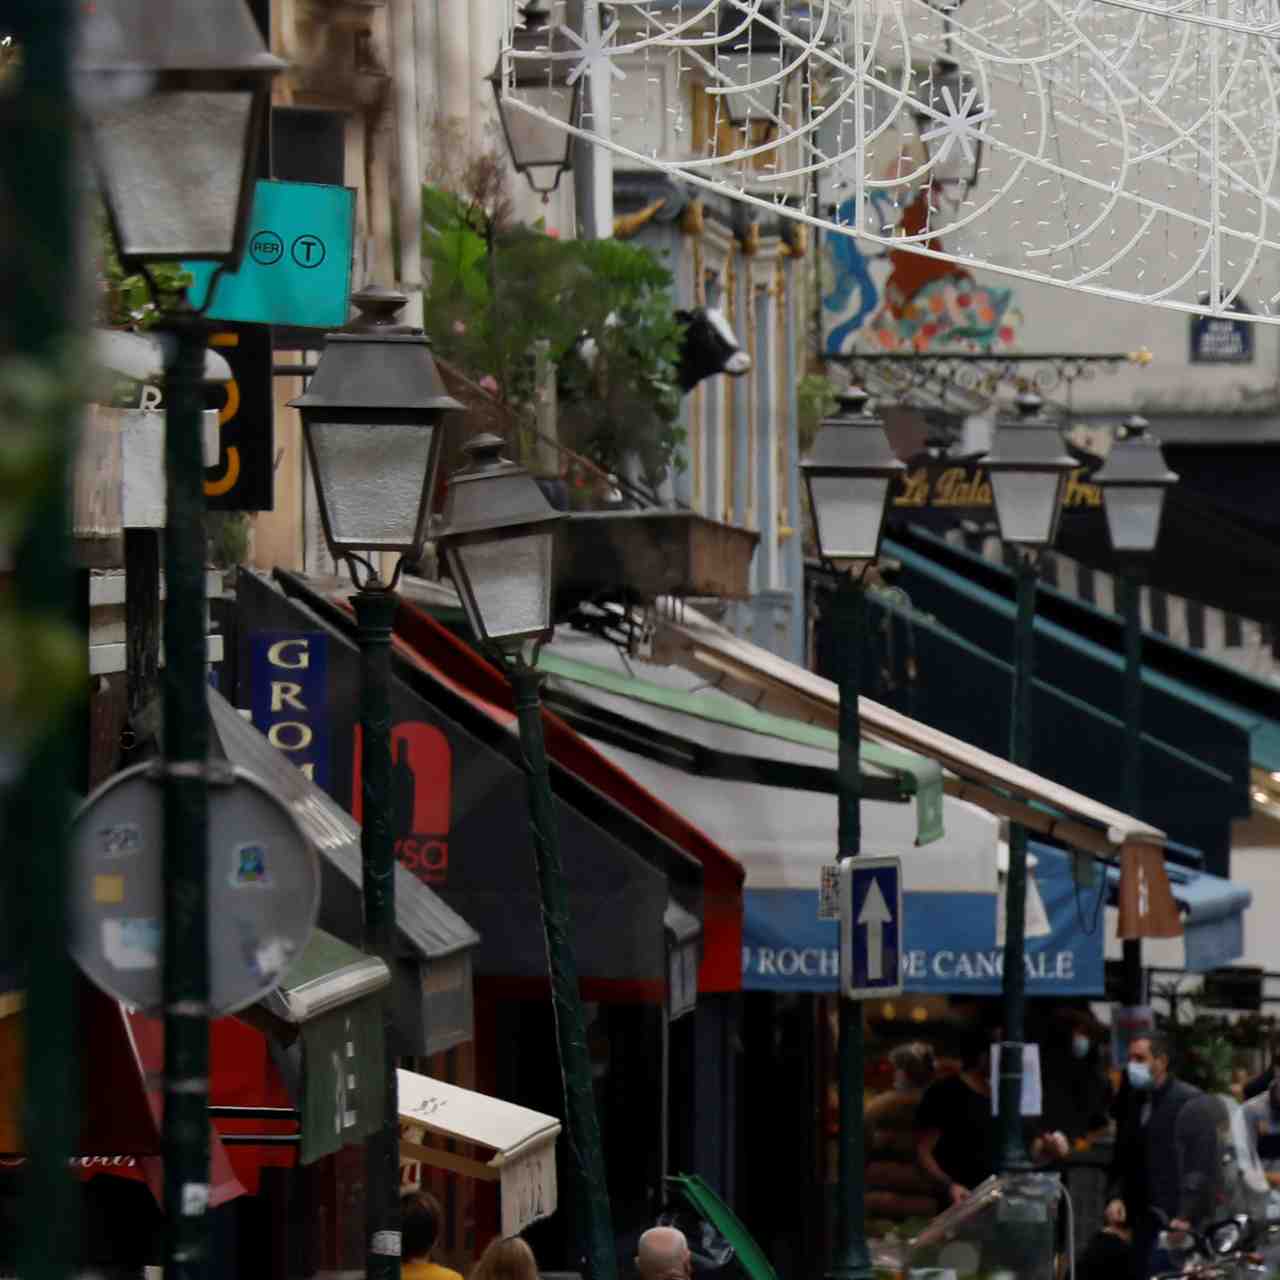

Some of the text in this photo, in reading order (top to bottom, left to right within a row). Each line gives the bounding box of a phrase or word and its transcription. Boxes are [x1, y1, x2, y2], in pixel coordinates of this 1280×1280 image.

[253, 241, 280, 254] RER
[299, 240, 317, 263] T
[757, 946, 839, 979] ROCH
